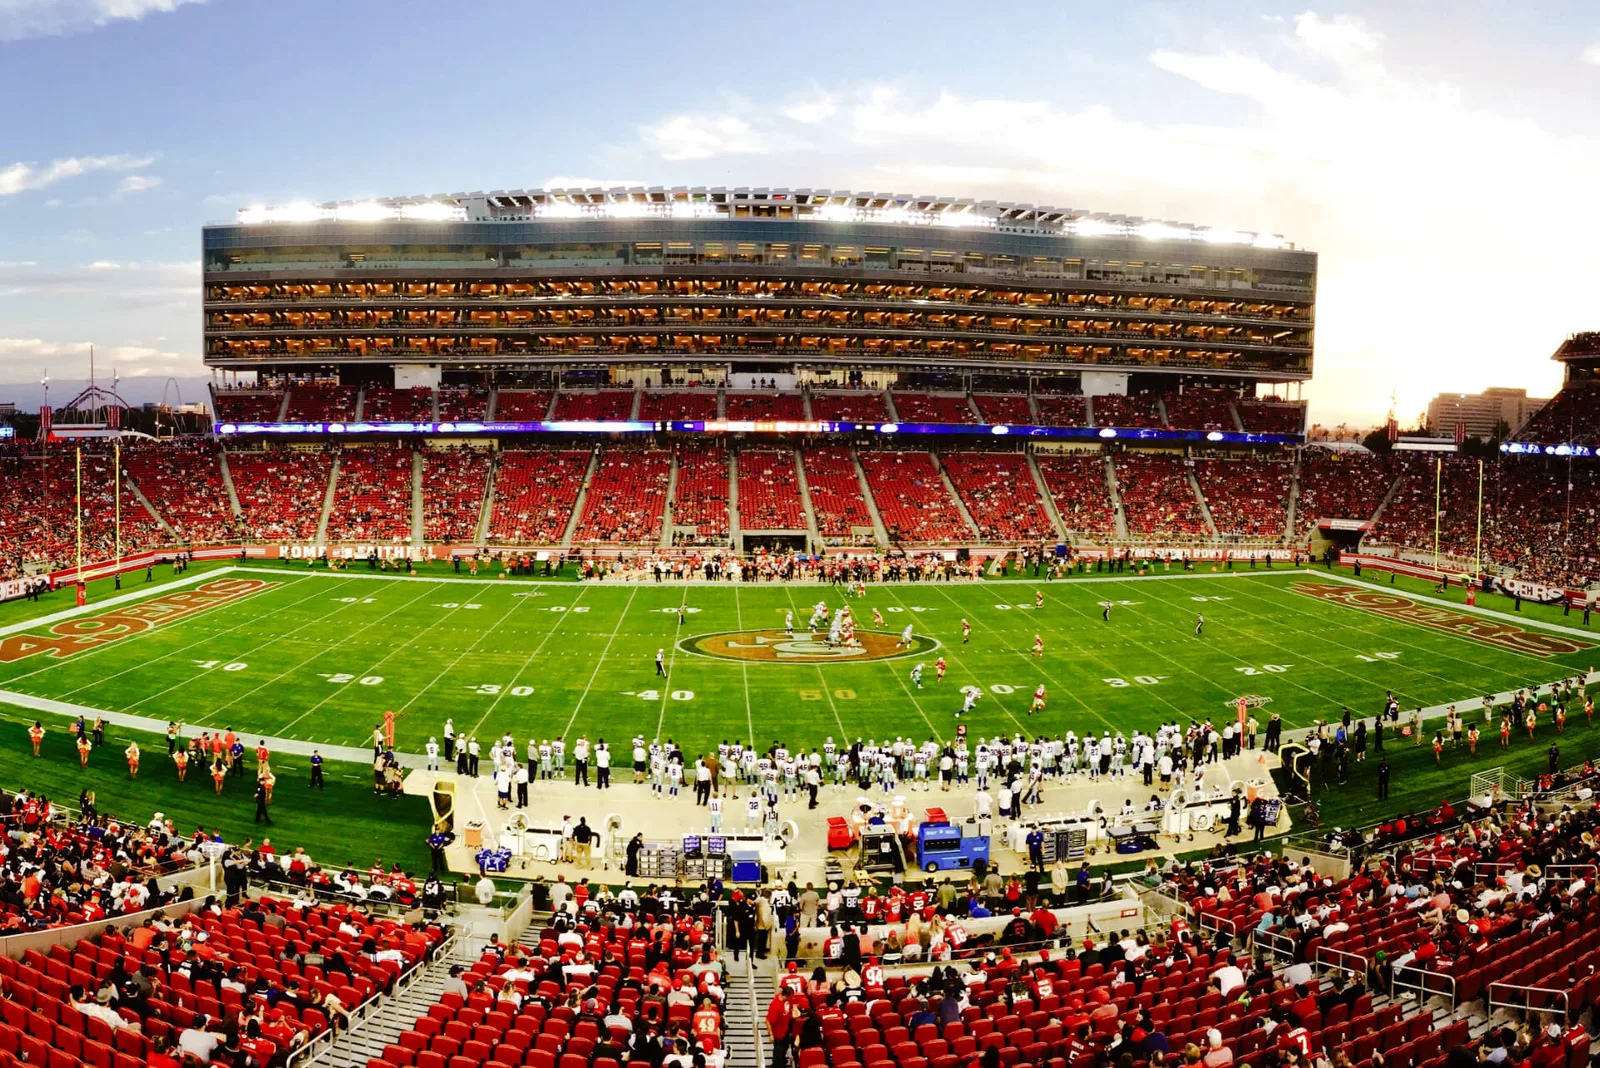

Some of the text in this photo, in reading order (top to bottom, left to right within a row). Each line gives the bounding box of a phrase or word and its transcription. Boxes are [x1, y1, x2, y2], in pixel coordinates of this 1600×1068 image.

[1234, 664, 1288, 676] 20
[327, 673, 384, 686] 20
[1102, 675, 1160, 688] 30
[475, 684, 535, 696] 30
[637, 690, 695, 701] 40
[799, 689, 857, 700] 50
[711, 802, 718, 811] 11
[749, 801, 759, 810] 32
[768, 811, 776, 820] 13
[425, 883, 439, 895] 54
[624, 899, 631, 909] 9
[84, 911, 91, 921] 7
[952, 929, 967, 945] 16
[866, 969, 883, 986] 94
[699, 1018, 715, 1032] 49
[1296, 1035, 1308, 1055] 7
